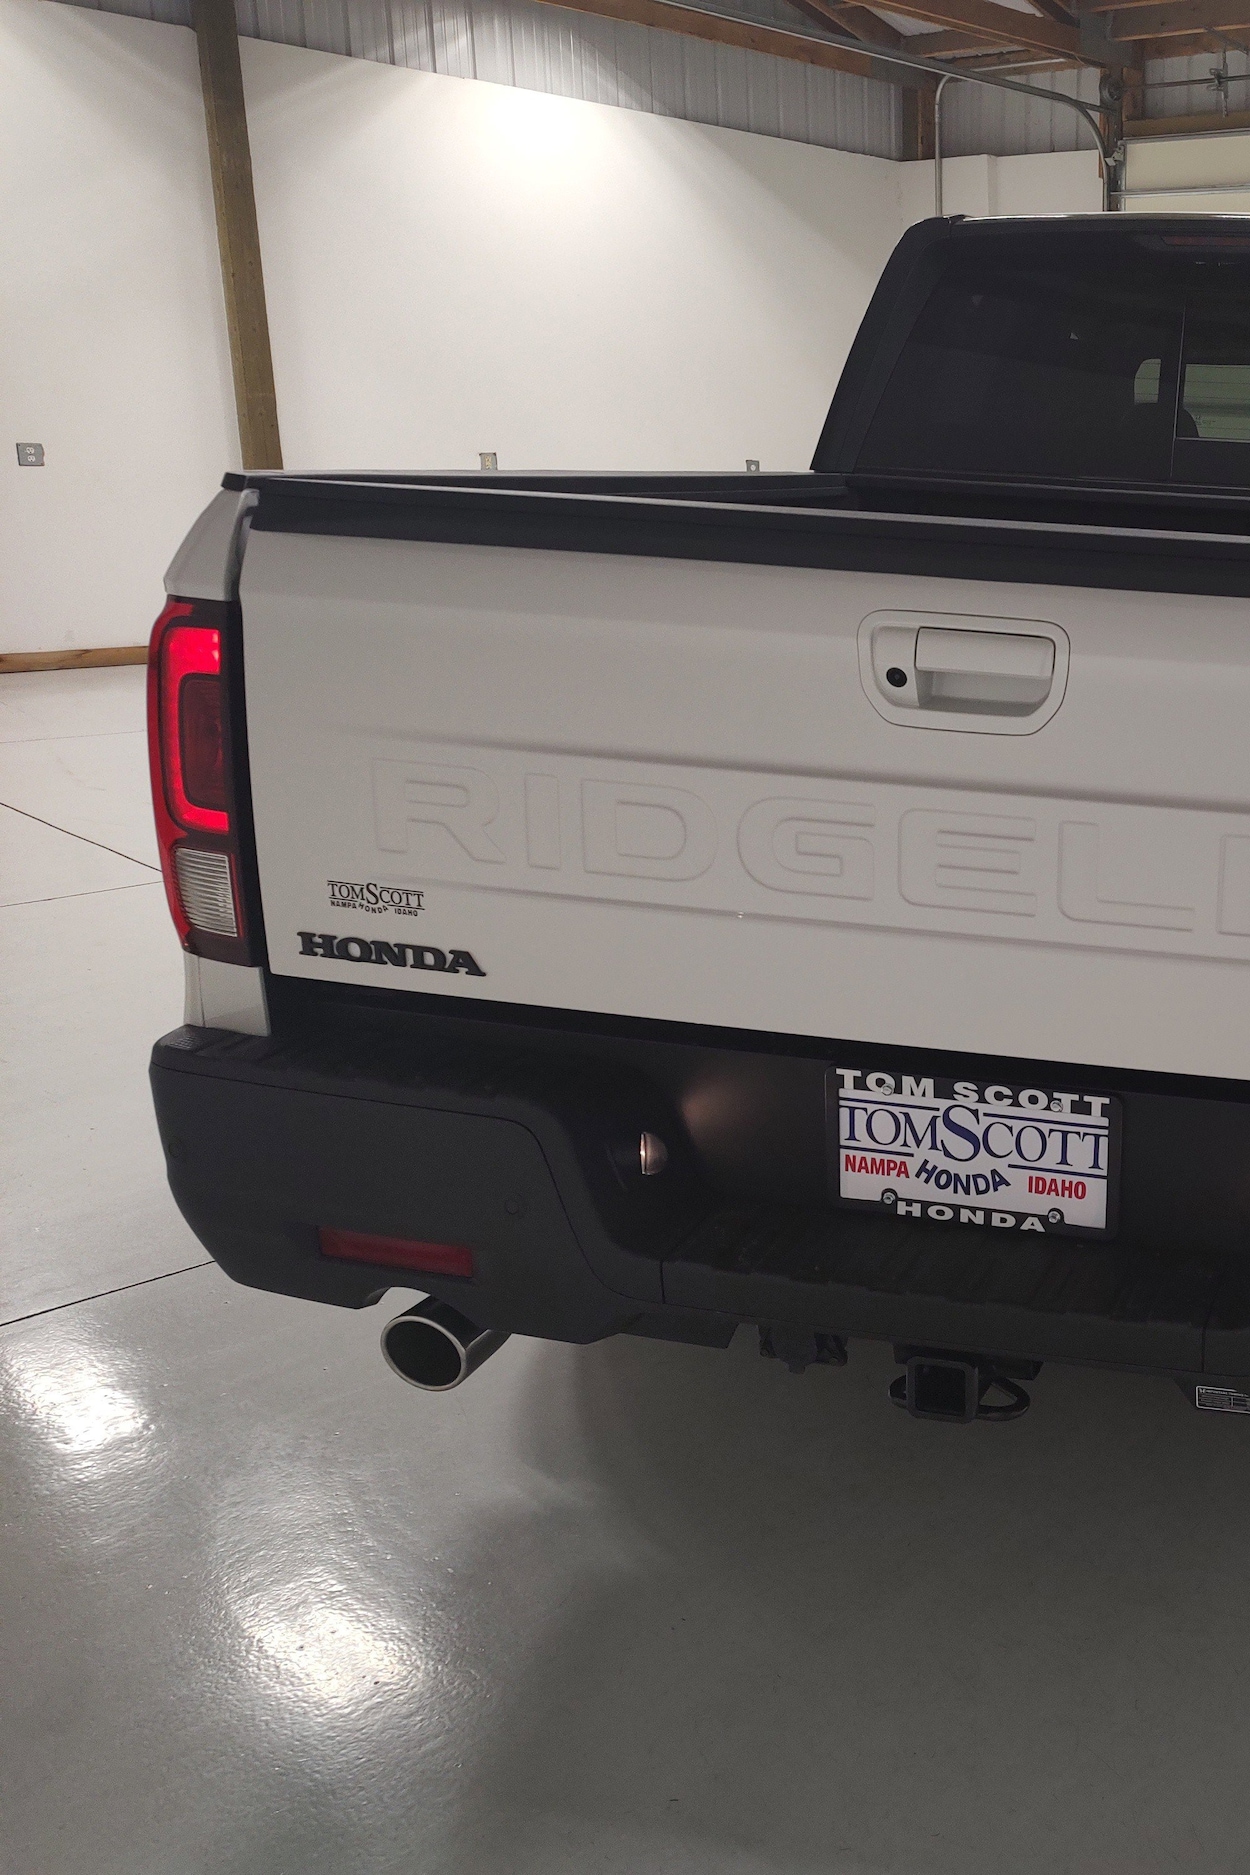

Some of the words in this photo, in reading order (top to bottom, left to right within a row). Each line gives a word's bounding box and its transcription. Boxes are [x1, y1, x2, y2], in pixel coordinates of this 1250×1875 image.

[330, 900, 357, 910] NAMPA
[358, 903, 389, 914] HONDA
[394, 908, 418, 917] IDAHO
[297, 931, 487, 977] HONDA
[836, 1067, 935, 1097] TOM
[953, 1081, 1110, 1118] SCOTT
[845, 1154, 910, 1178] NAMPA
[914, 1158, 1011, 1196] HONDA
[1027, 1175, 1087, 1200] IDAHO
[896, 1200, 1046, 1232] HONDA
